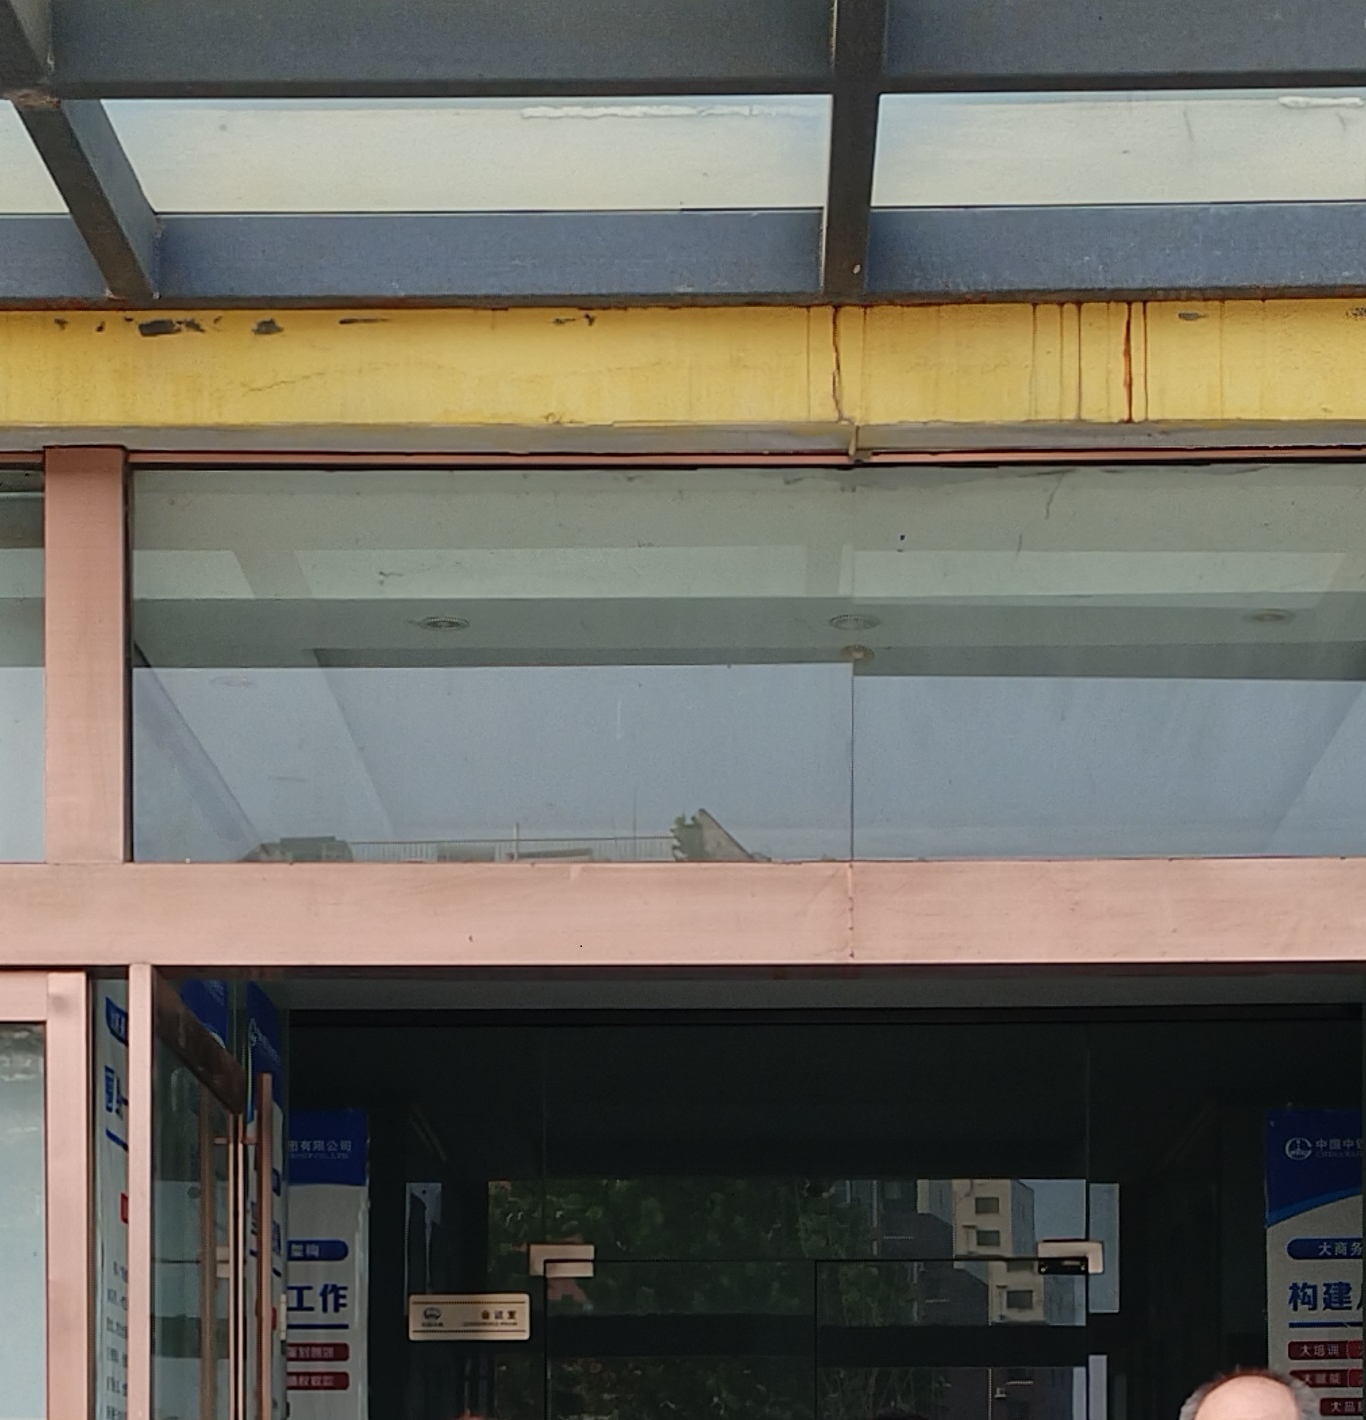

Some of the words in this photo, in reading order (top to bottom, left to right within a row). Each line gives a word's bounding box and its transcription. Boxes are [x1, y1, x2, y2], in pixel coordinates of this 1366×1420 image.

[1318, 1242, 1362, 1256] 大商务
[1288, 1282, 1362, 1312] 构建
